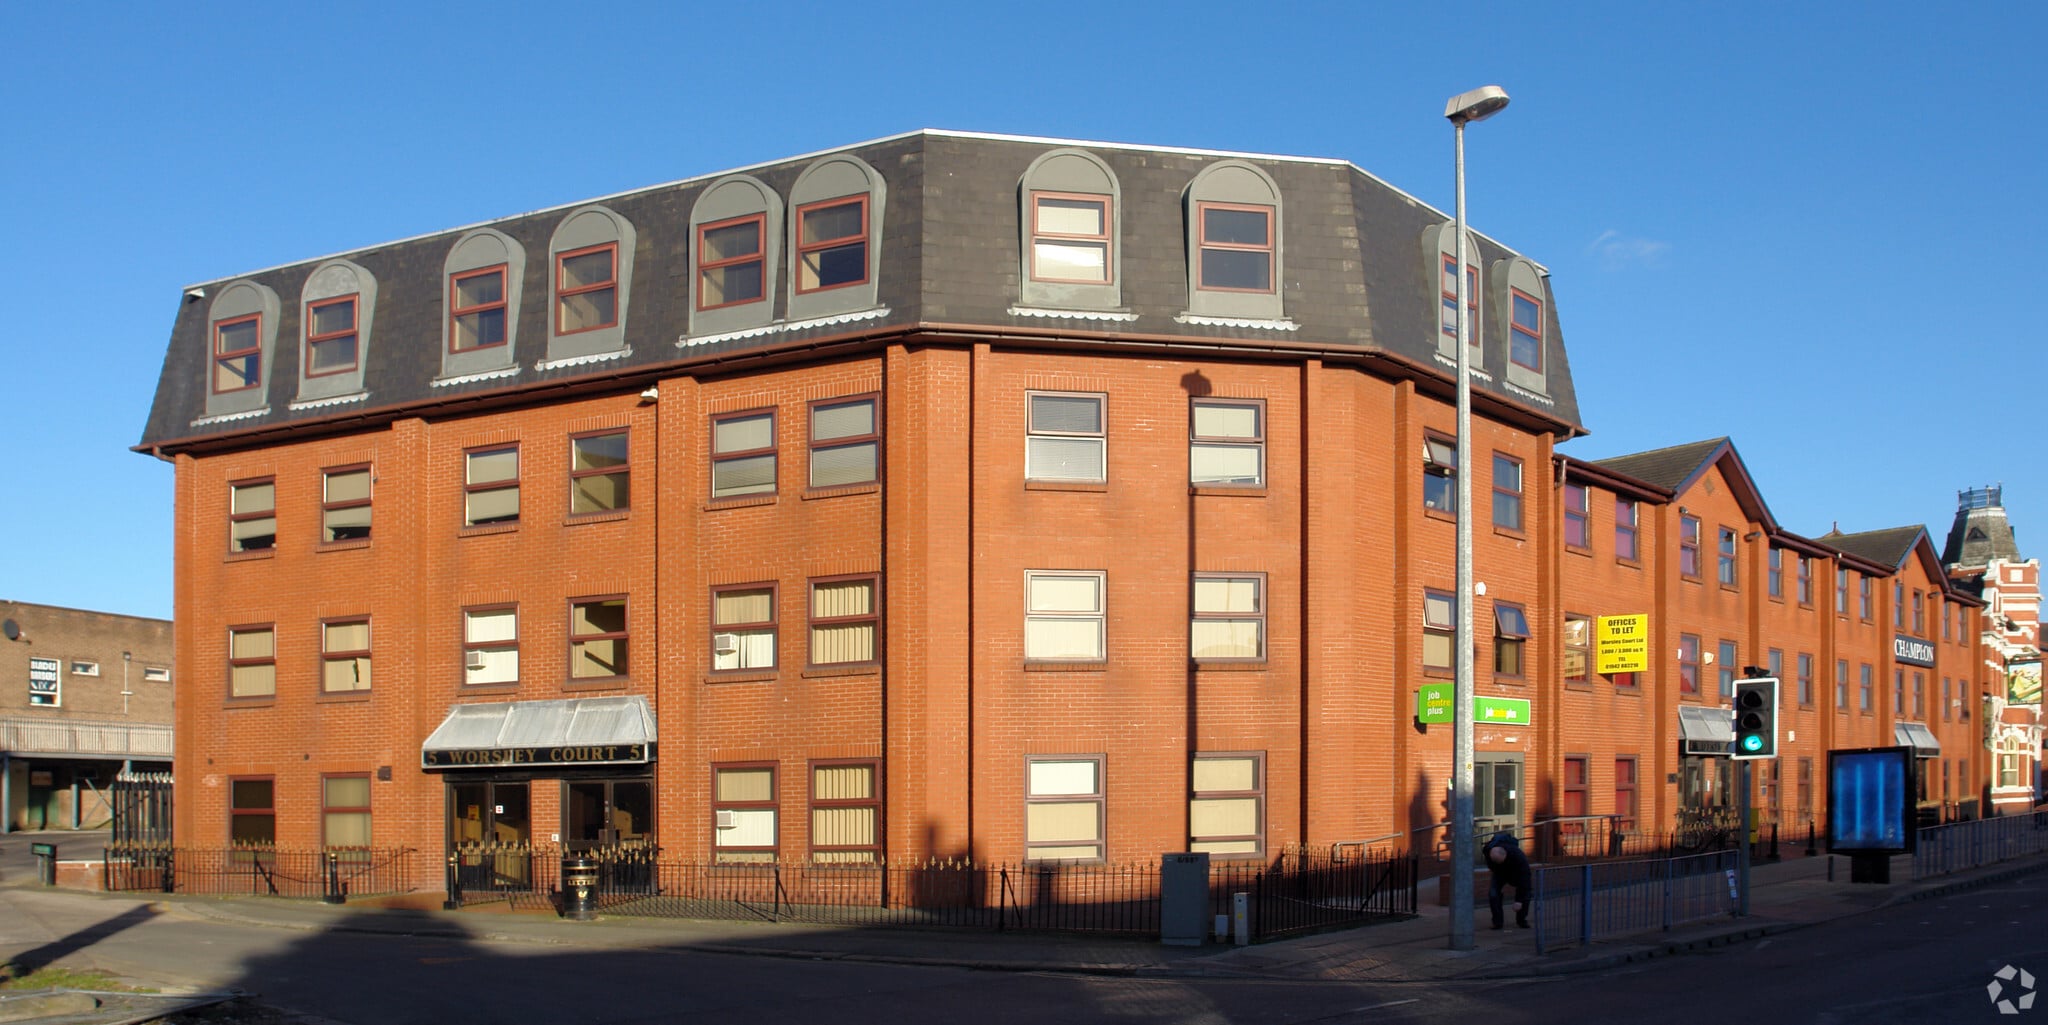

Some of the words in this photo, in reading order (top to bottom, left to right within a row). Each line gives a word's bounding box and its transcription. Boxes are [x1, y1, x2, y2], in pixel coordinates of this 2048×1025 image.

[1608, 618, 1637, 626] OFFICES
[1611, 627, 1621, 635] TO
[1622, 626, 1634, 634] LET
[1427, 691, 1440, 700] job
[1427, 699, 1451, 708] centre
[1427, 707, 1444, 717] plus
[428, 751, 438, 765] 5
[550, 746, 618, 762] COURT
[629, 744, 641, 761] 5
